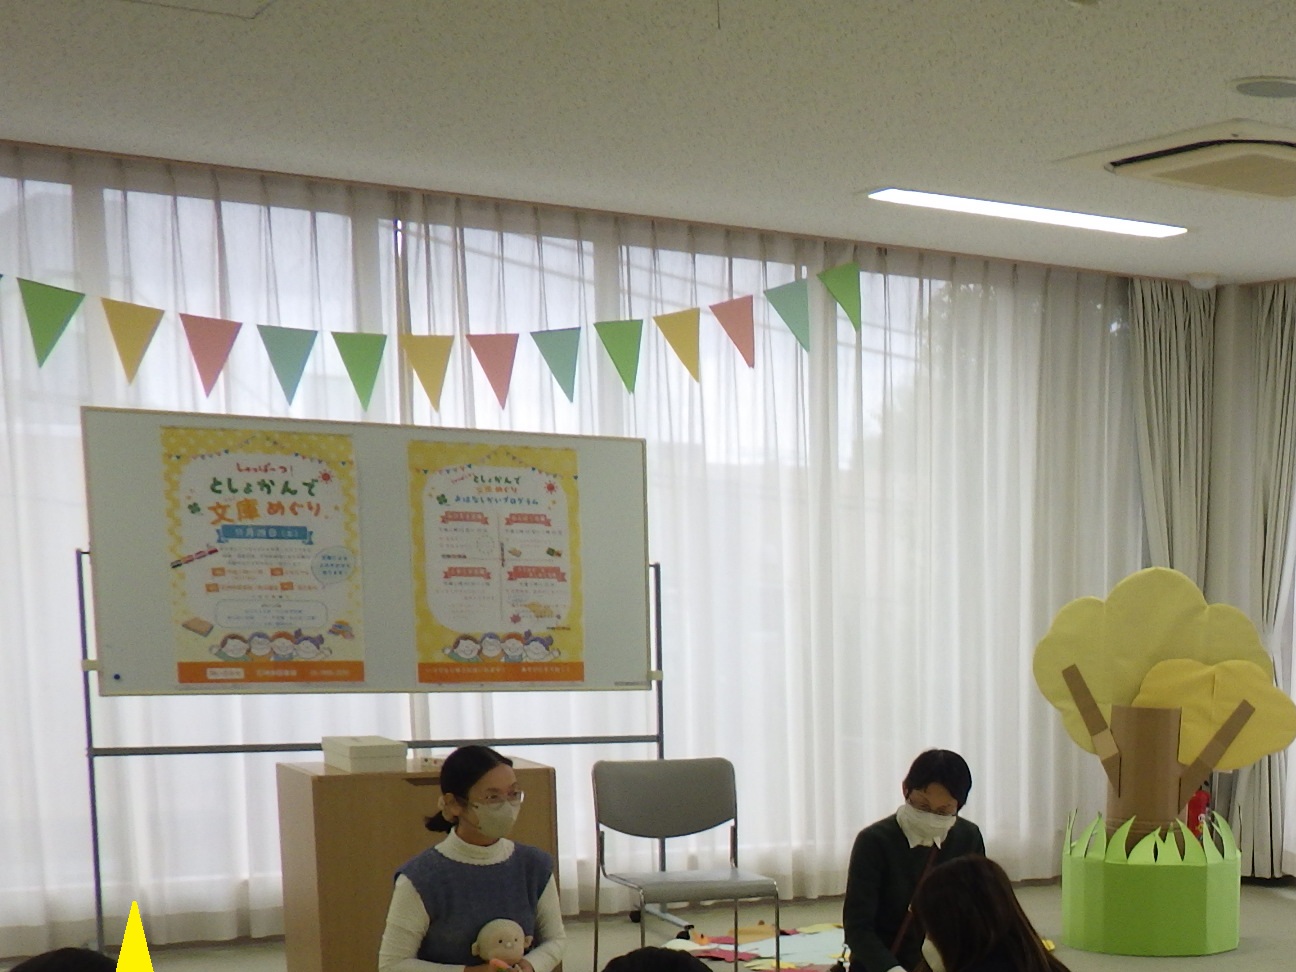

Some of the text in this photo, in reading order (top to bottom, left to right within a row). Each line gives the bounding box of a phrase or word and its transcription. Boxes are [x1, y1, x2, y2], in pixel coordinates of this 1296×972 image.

[209, 476, 319, 497] としょかんで
[207, 498, 321, 525] 文庫めぐり
